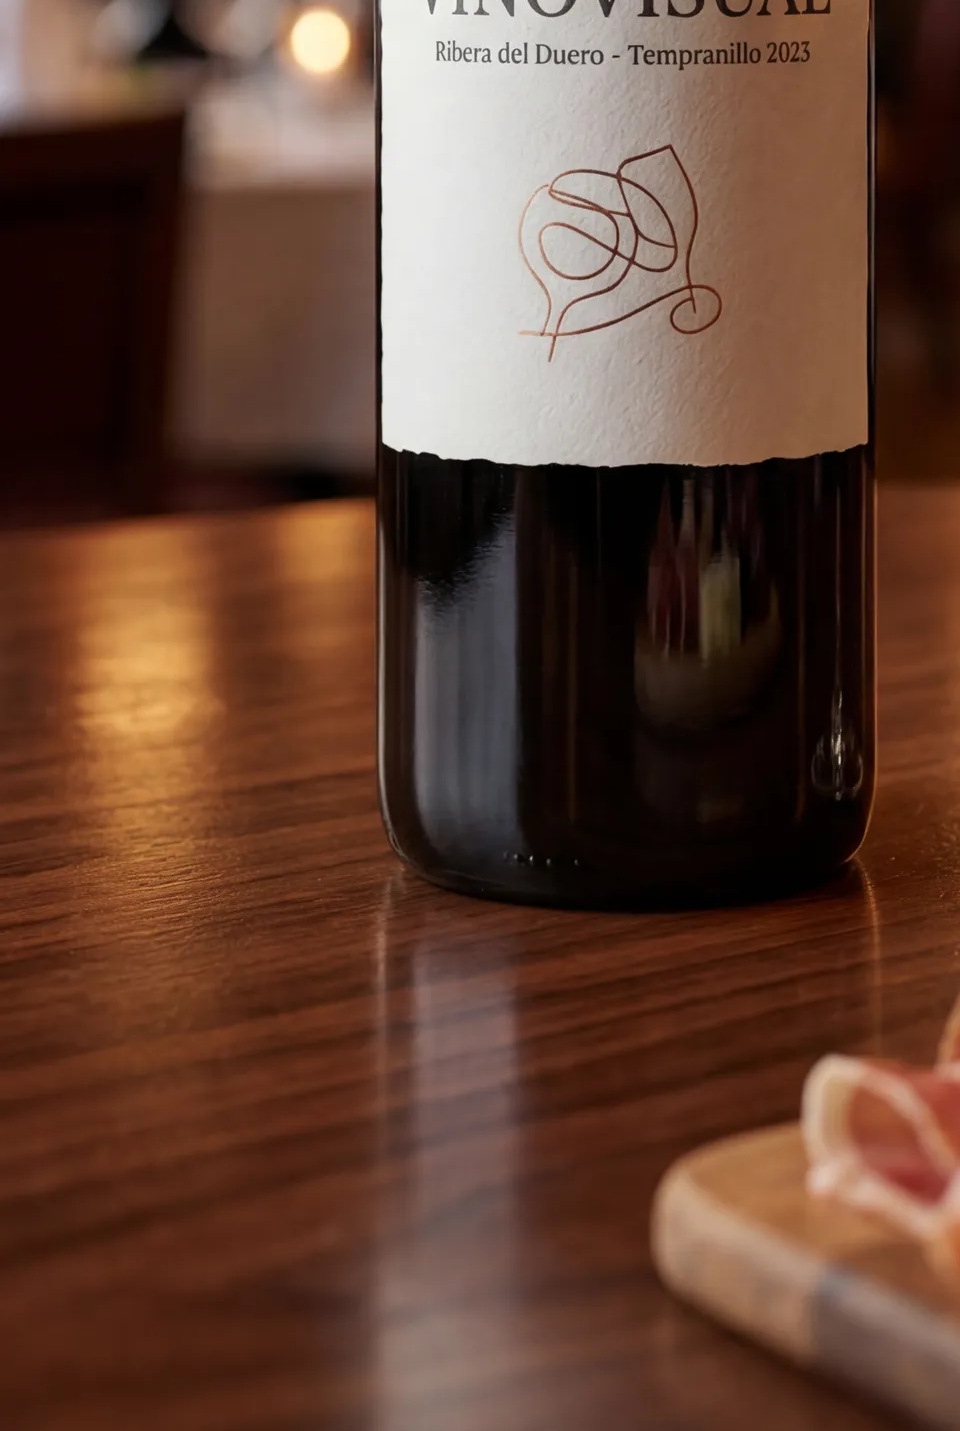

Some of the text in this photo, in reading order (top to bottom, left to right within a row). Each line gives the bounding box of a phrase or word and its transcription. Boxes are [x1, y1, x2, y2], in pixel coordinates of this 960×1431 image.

[437, 41, 491, 63] Ribera
[498, 42, 528, 64] del
[536, 44, 604, 65] Duero
[628, 42, 761, 70] Tempranillo
[767, 41, 810, 63] 2023
